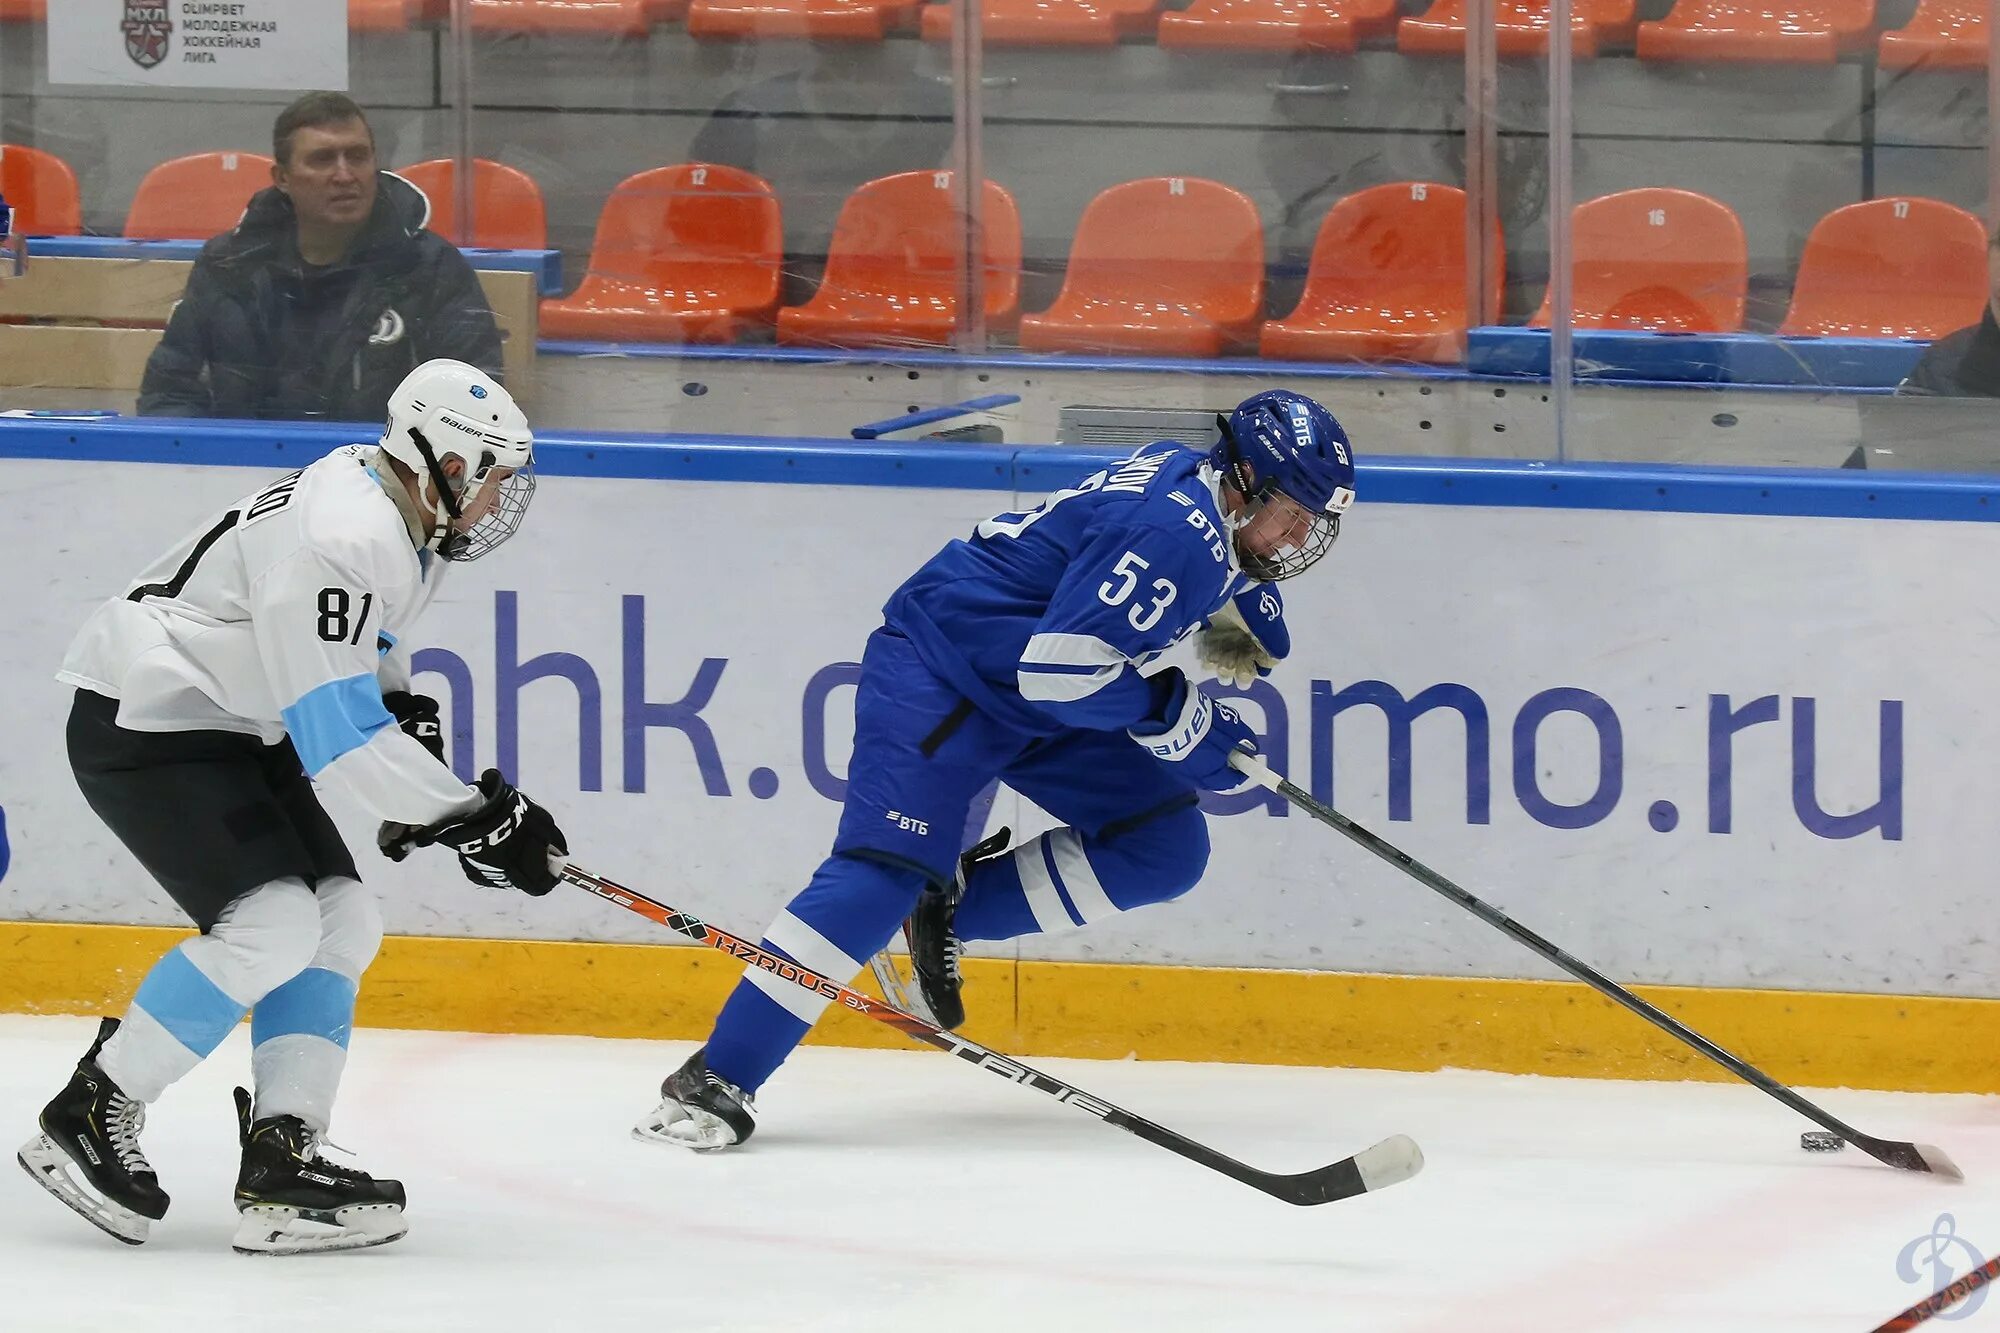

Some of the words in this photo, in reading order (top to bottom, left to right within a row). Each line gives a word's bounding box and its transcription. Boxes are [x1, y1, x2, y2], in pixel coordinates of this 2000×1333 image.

[183, 20, 277, 32] МОЛОДЕЖНАЯ
[183, 33, 261, 48] ХОККЕЙНАЯ
[183, 52, 216, 63] ЛИГА
[691, 168, 707, 185] 12
[933, 172, 949, 188] 13
[1169, 178, 1185, 195] 14
[1411, 184, 1427, 201] 15
[1648, 209, 1665, 226] 16
[1893, 201, 1910, 218] 17
[440, 416, 484, 438] BAUER
[1292, 416, 1312, 447] ВТБ
[1186, 508, 1226, 563] ВТБ
[1097, 550, 1178, 632] 53
[317, 587, 373, 646] 81
[1152, 691, 1210, 757] AUER
[457, 793, 528, 855] CCM
[899, 815, 929, 836] ВТБ
[562, 872, 634, 908] TRUE
[714, 935, 841, 1001] HZRDUS
[935, 1030, 1114, 1120] TRUE
